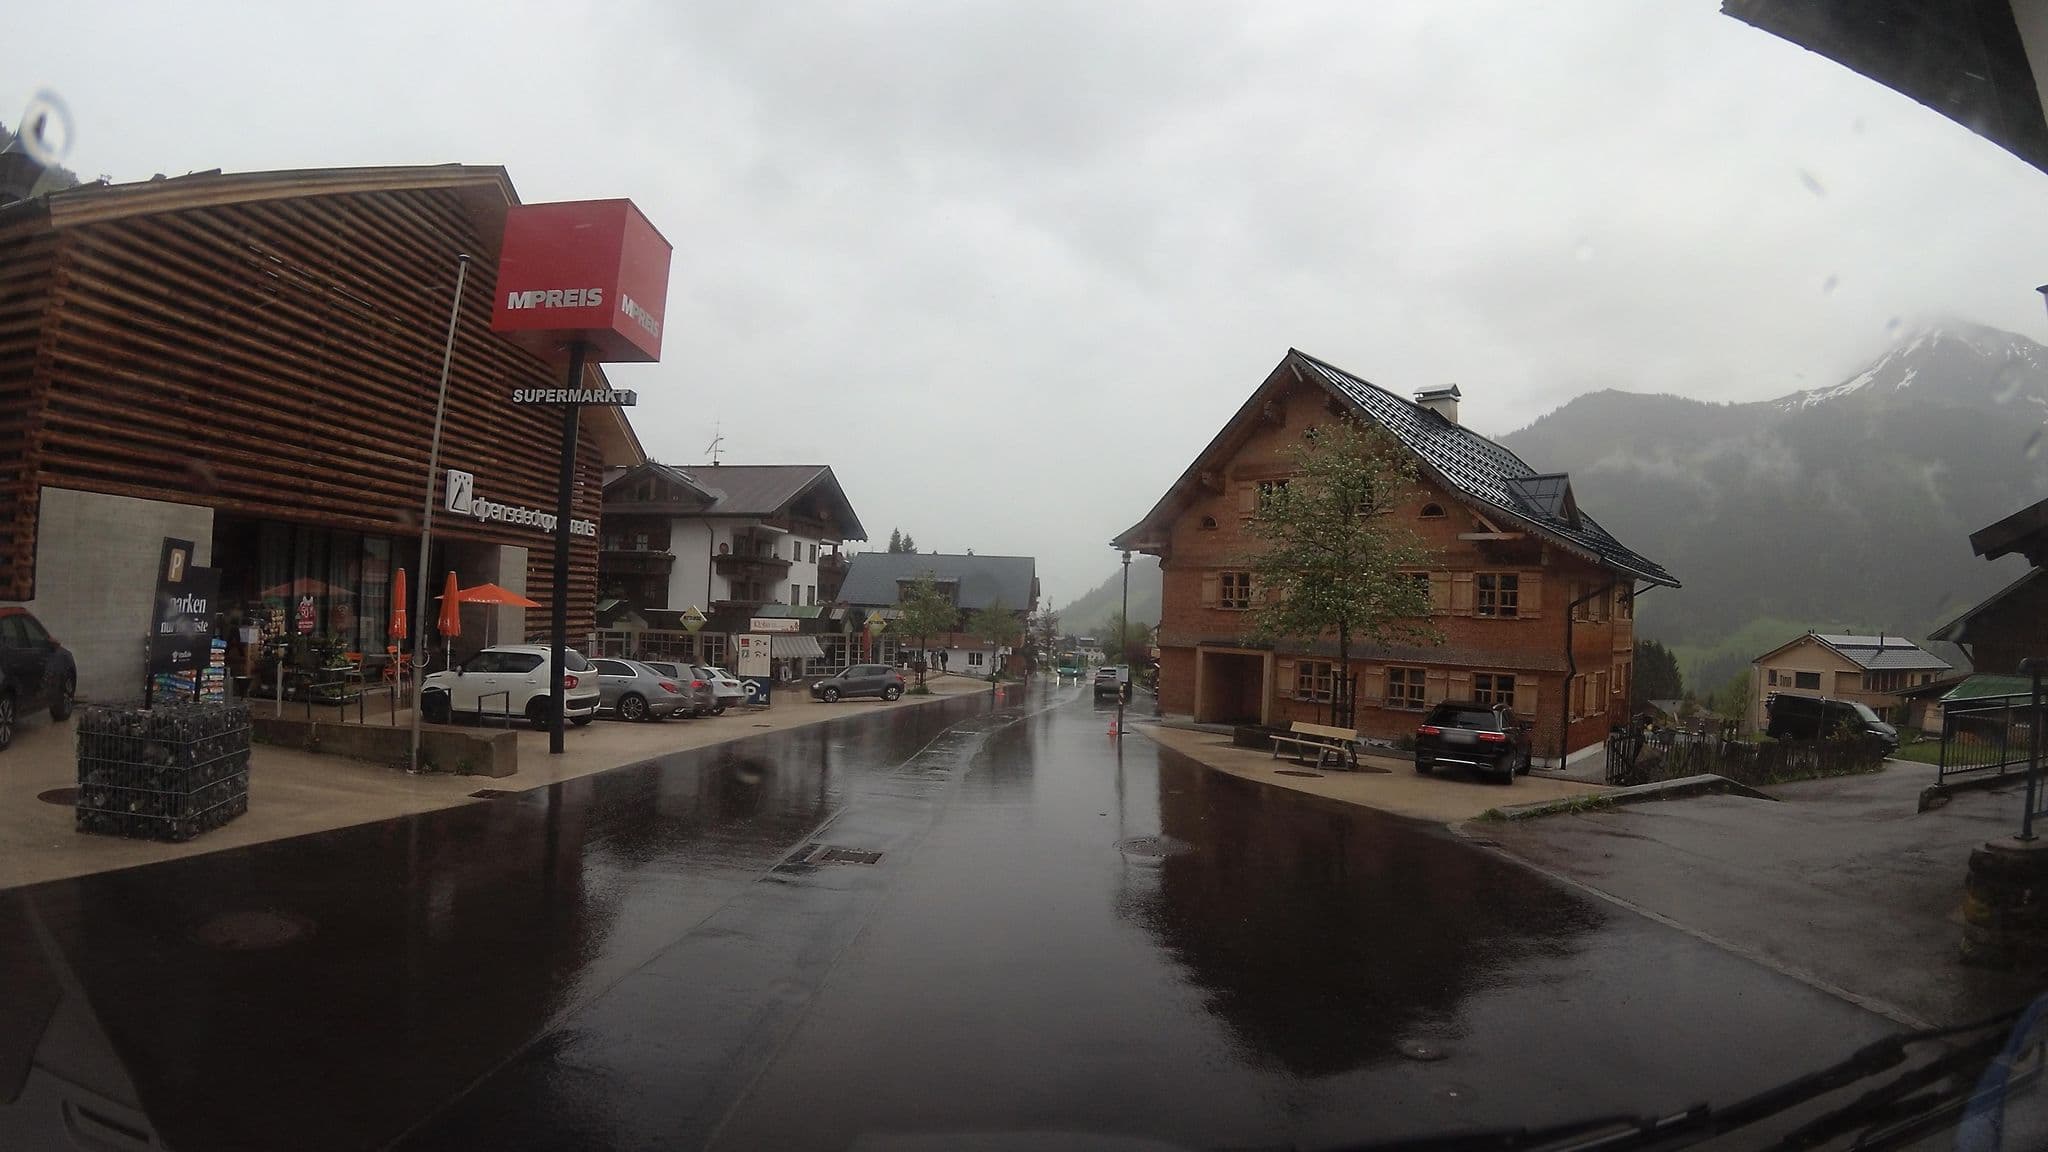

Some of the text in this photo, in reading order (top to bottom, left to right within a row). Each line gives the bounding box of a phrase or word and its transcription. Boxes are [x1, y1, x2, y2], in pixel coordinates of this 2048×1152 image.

[507, 288, 603, 310] MPREIS
[621, 294, 660, 338] MPREIS
[513, 388, 629, 404] SUPERMARKT
[171, 552, 182, 579] P
